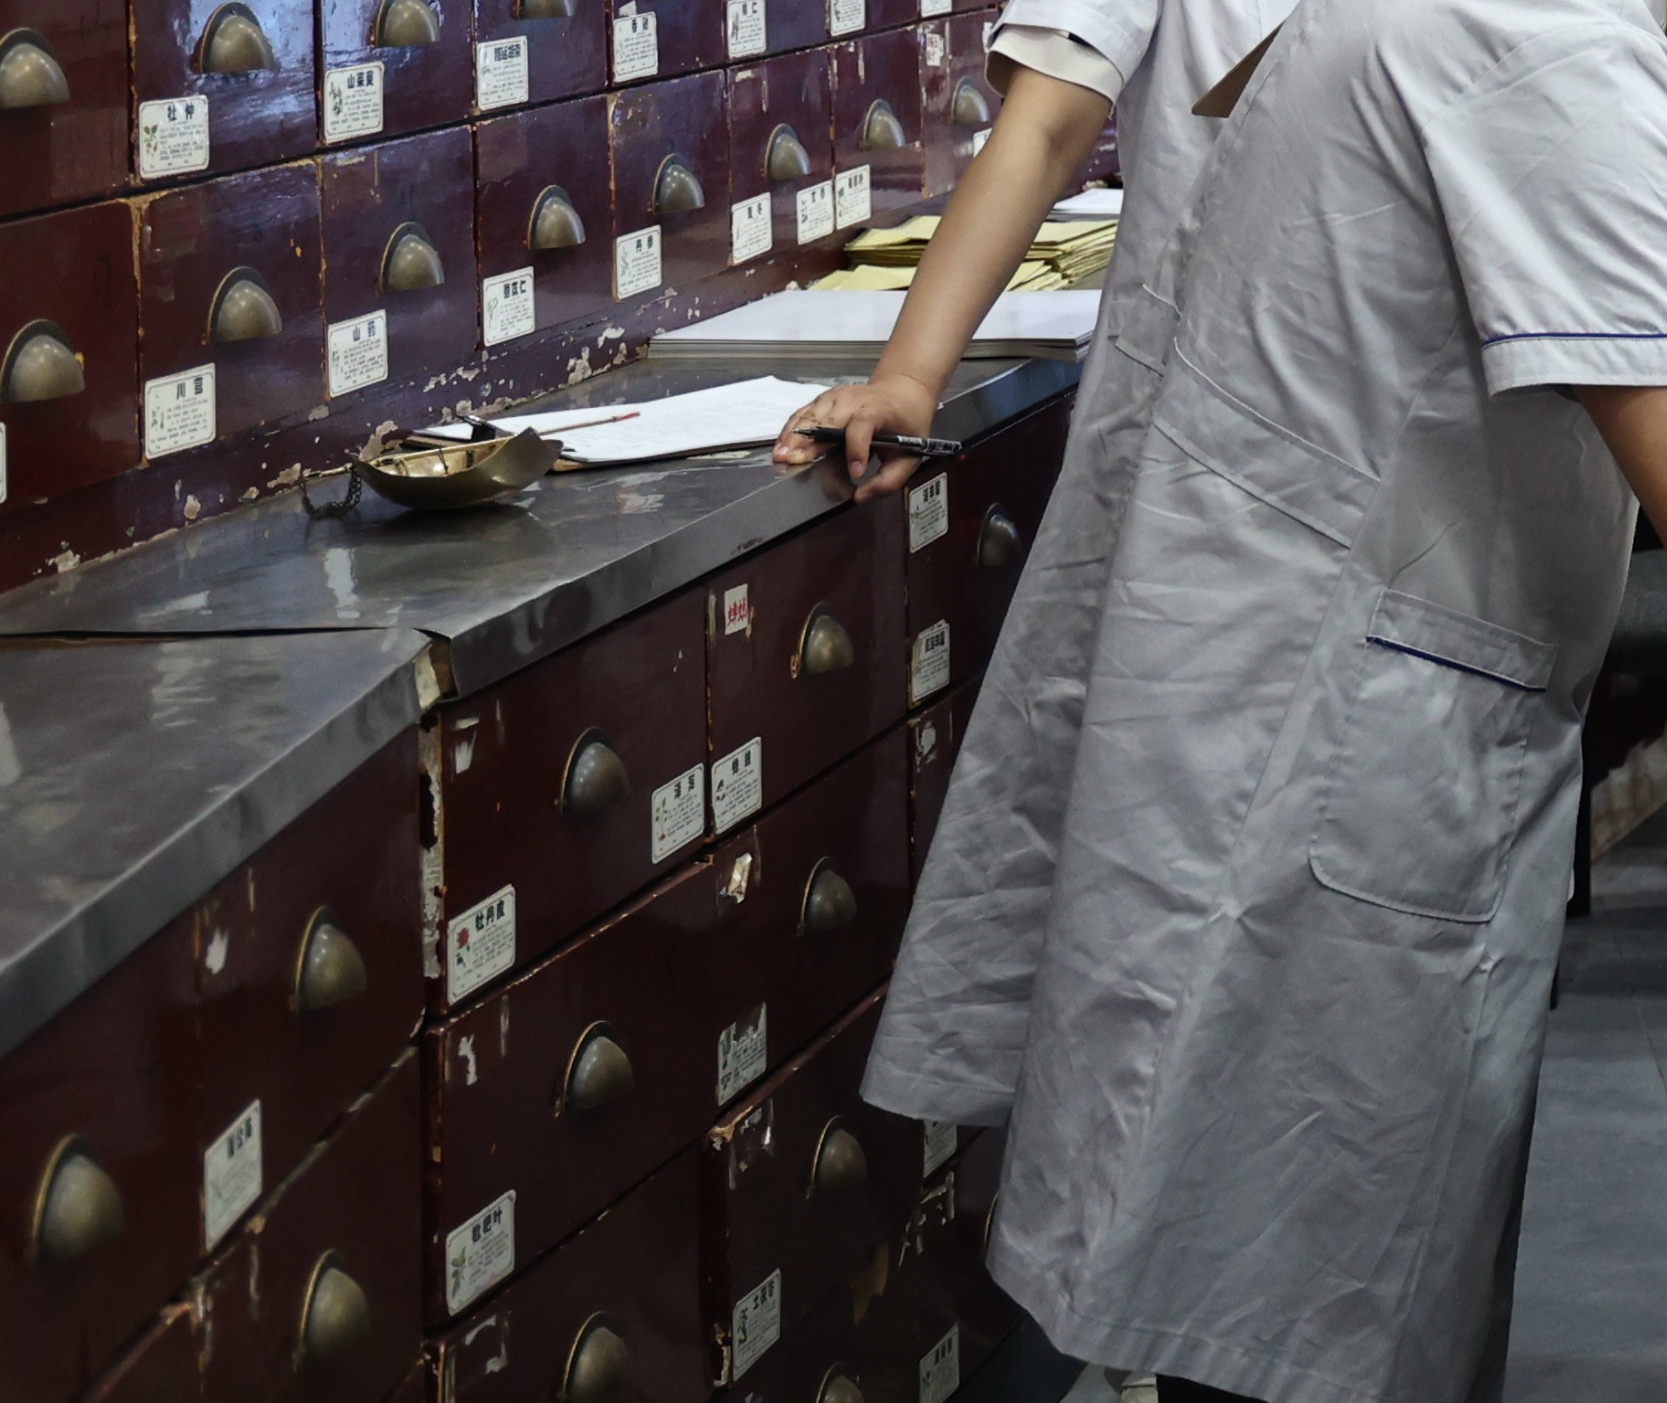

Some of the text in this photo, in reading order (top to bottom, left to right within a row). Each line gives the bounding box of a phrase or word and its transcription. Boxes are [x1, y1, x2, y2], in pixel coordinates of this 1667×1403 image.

[346, 69, 375, 90] 山茱萸
[635, 234, 654, 253] 丹参
[352, 320, 376, 343] 山药
[474, 899, 506, 933] 牡丹皮
